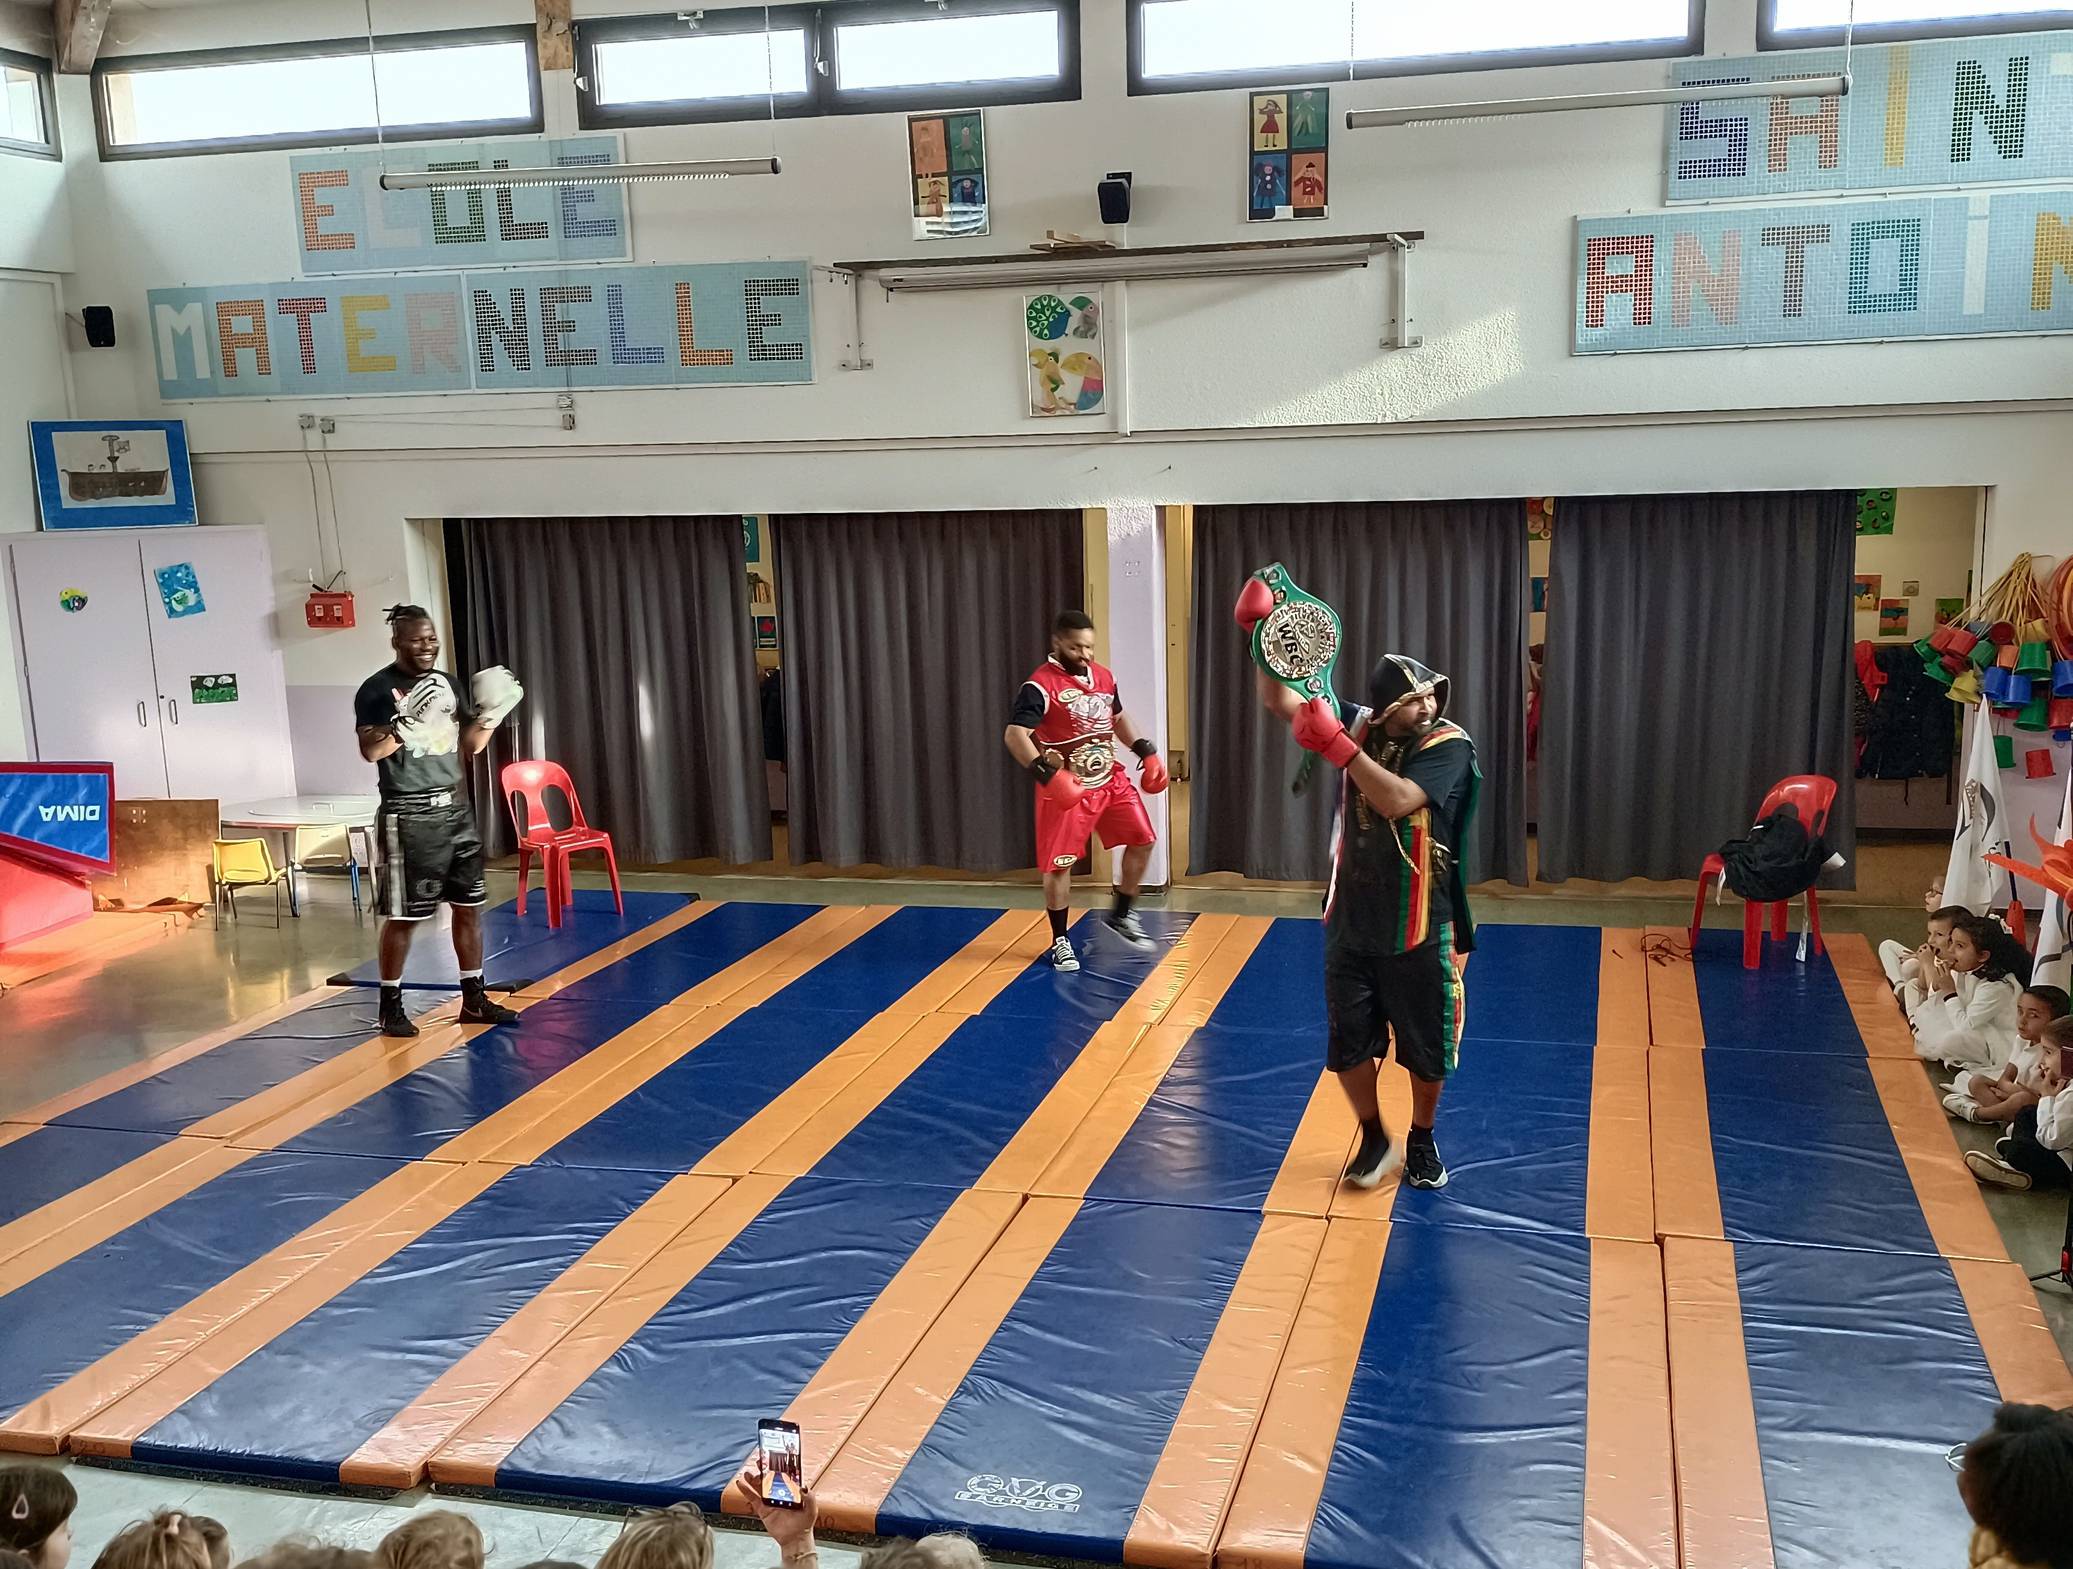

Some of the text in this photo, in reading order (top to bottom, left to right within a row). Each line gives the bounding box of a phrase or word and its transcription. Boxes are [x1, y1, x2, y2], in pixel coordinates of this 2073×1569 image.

[1677, 46, 2073, 180] SAIN
[297, 153, 617, 251] ECOLE
[156, 277, 804, 382] MATERNELLE
[1278, 621, 1303, 666] WBC
[38, 805, 101, 822] DIMA
